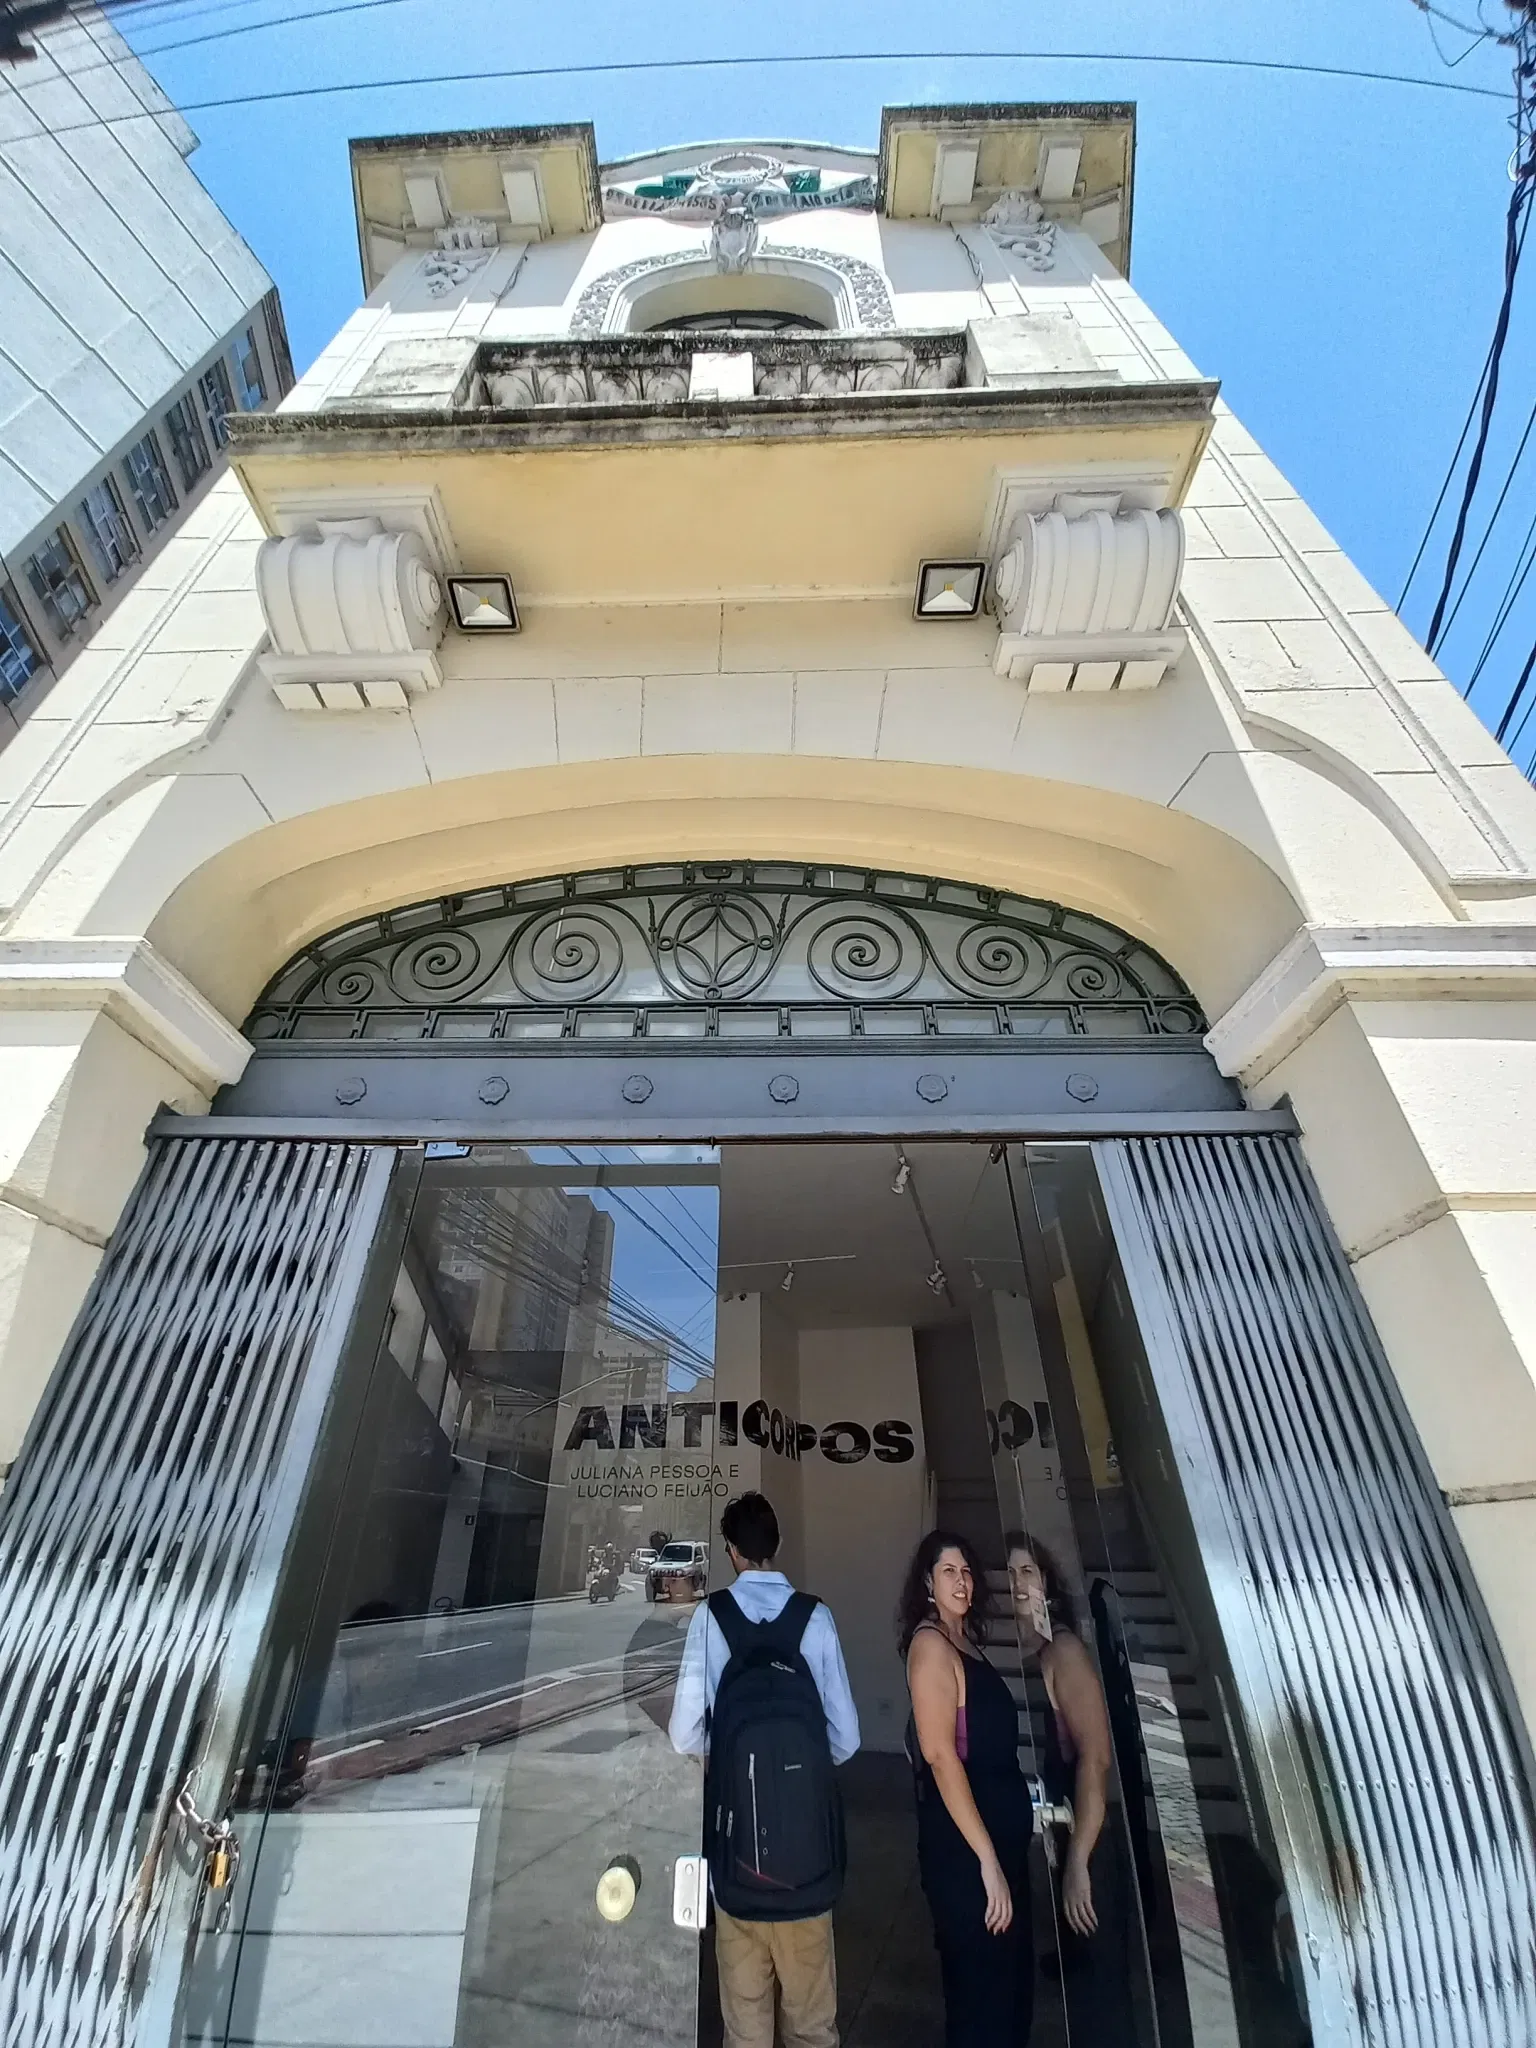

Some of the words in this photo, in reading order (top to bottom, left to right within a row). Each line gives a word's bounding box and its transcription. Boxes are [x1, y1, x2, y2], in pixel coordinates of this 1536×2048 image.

[563, 1400, 915, 1464] ANTICORPOS
[570, 1465, 644, 1480] JULIANA
[650, 1464, 723, 1479] PESSOA
[729, 1464, 740, 1478] E
[577, 1484, 658, 1498] LUCIANO
[664, 1479, 729, 1498] FEIJÃO
